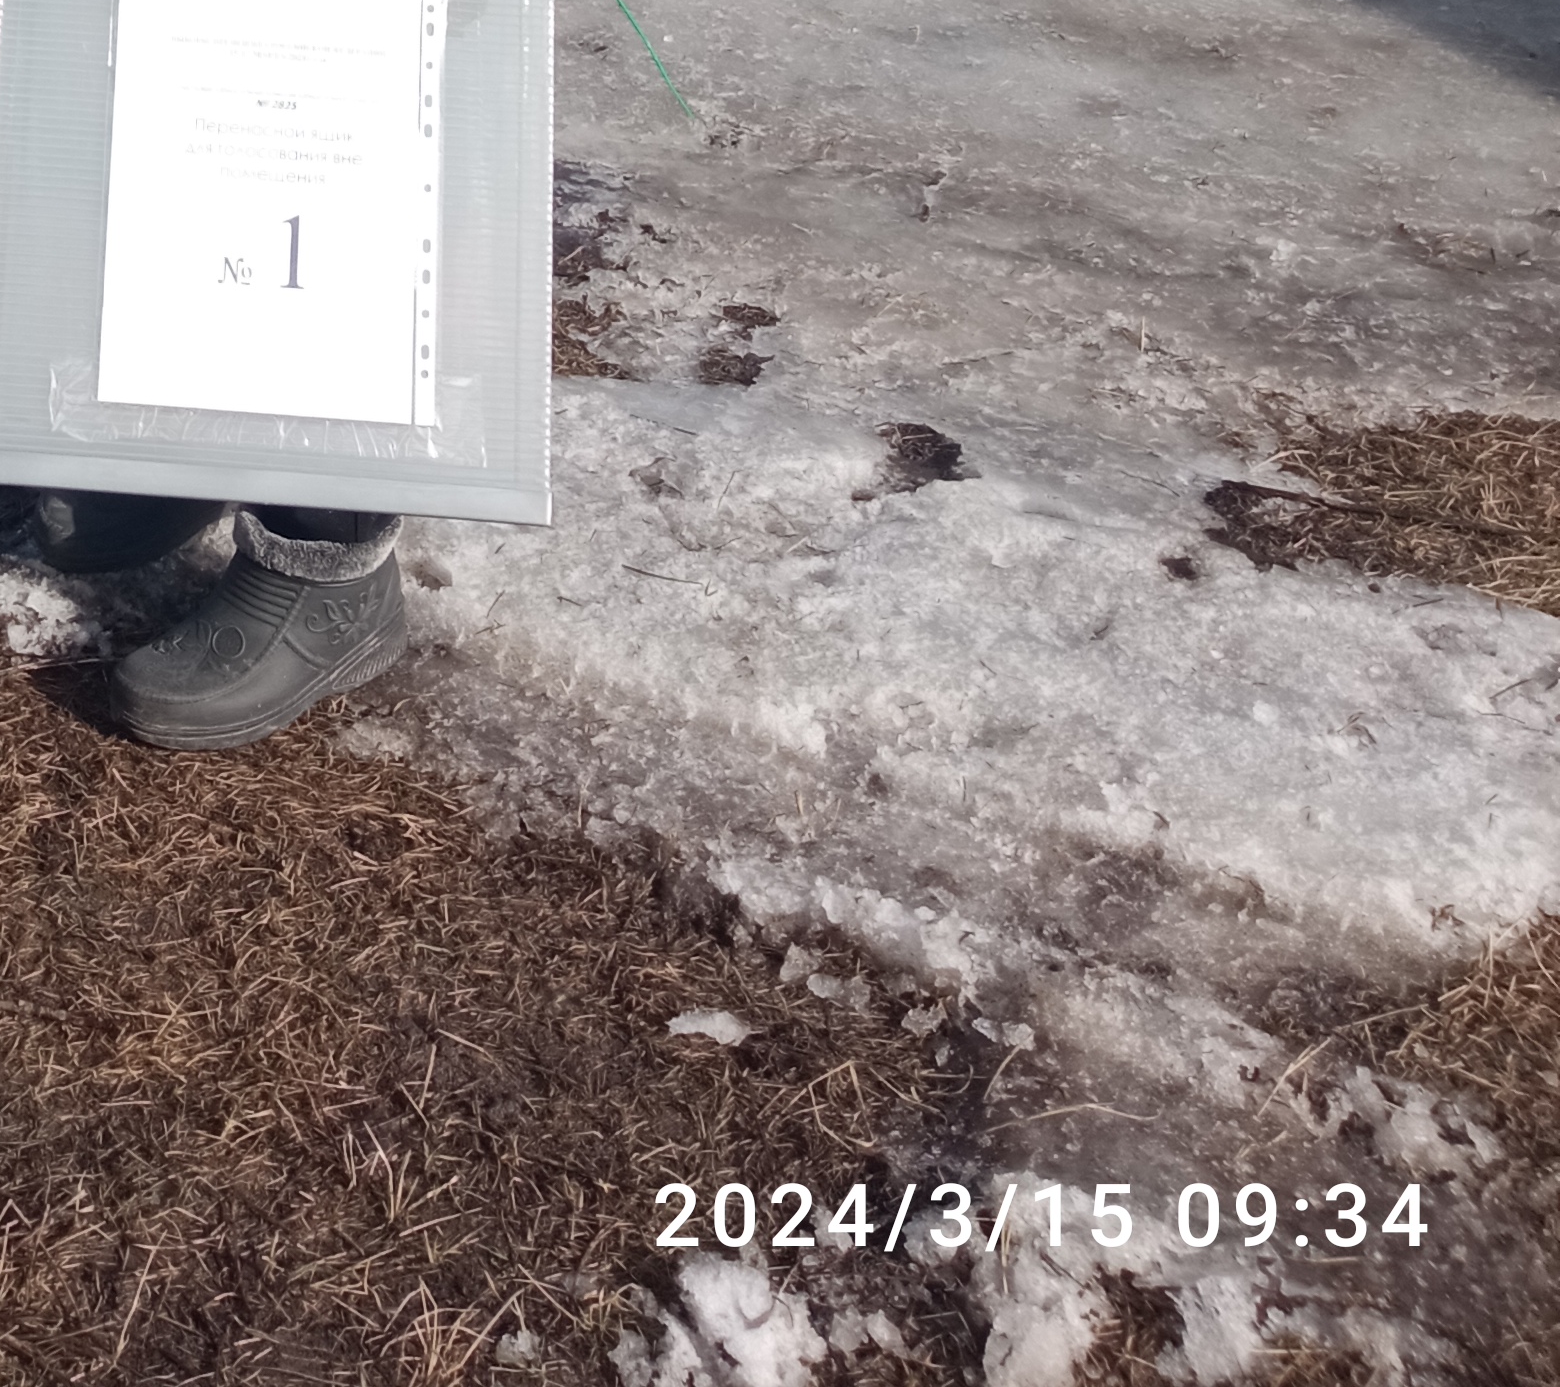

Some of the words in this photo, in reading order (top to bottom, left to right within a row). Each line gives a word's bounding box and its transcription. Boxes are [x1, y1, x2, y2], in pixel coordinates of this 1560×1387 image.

[195, 117, 305, 139] Переносной
[311, 129, 354, 143] ящик
[185, 143, 213, 155] для
[218, 144, 327, 163] голосования
[333, 153, 363, 166] вне
[220, 166, 326, 186] помещения
[217, 256, 253, 286] №
[280, 214, 305, 290] 1
